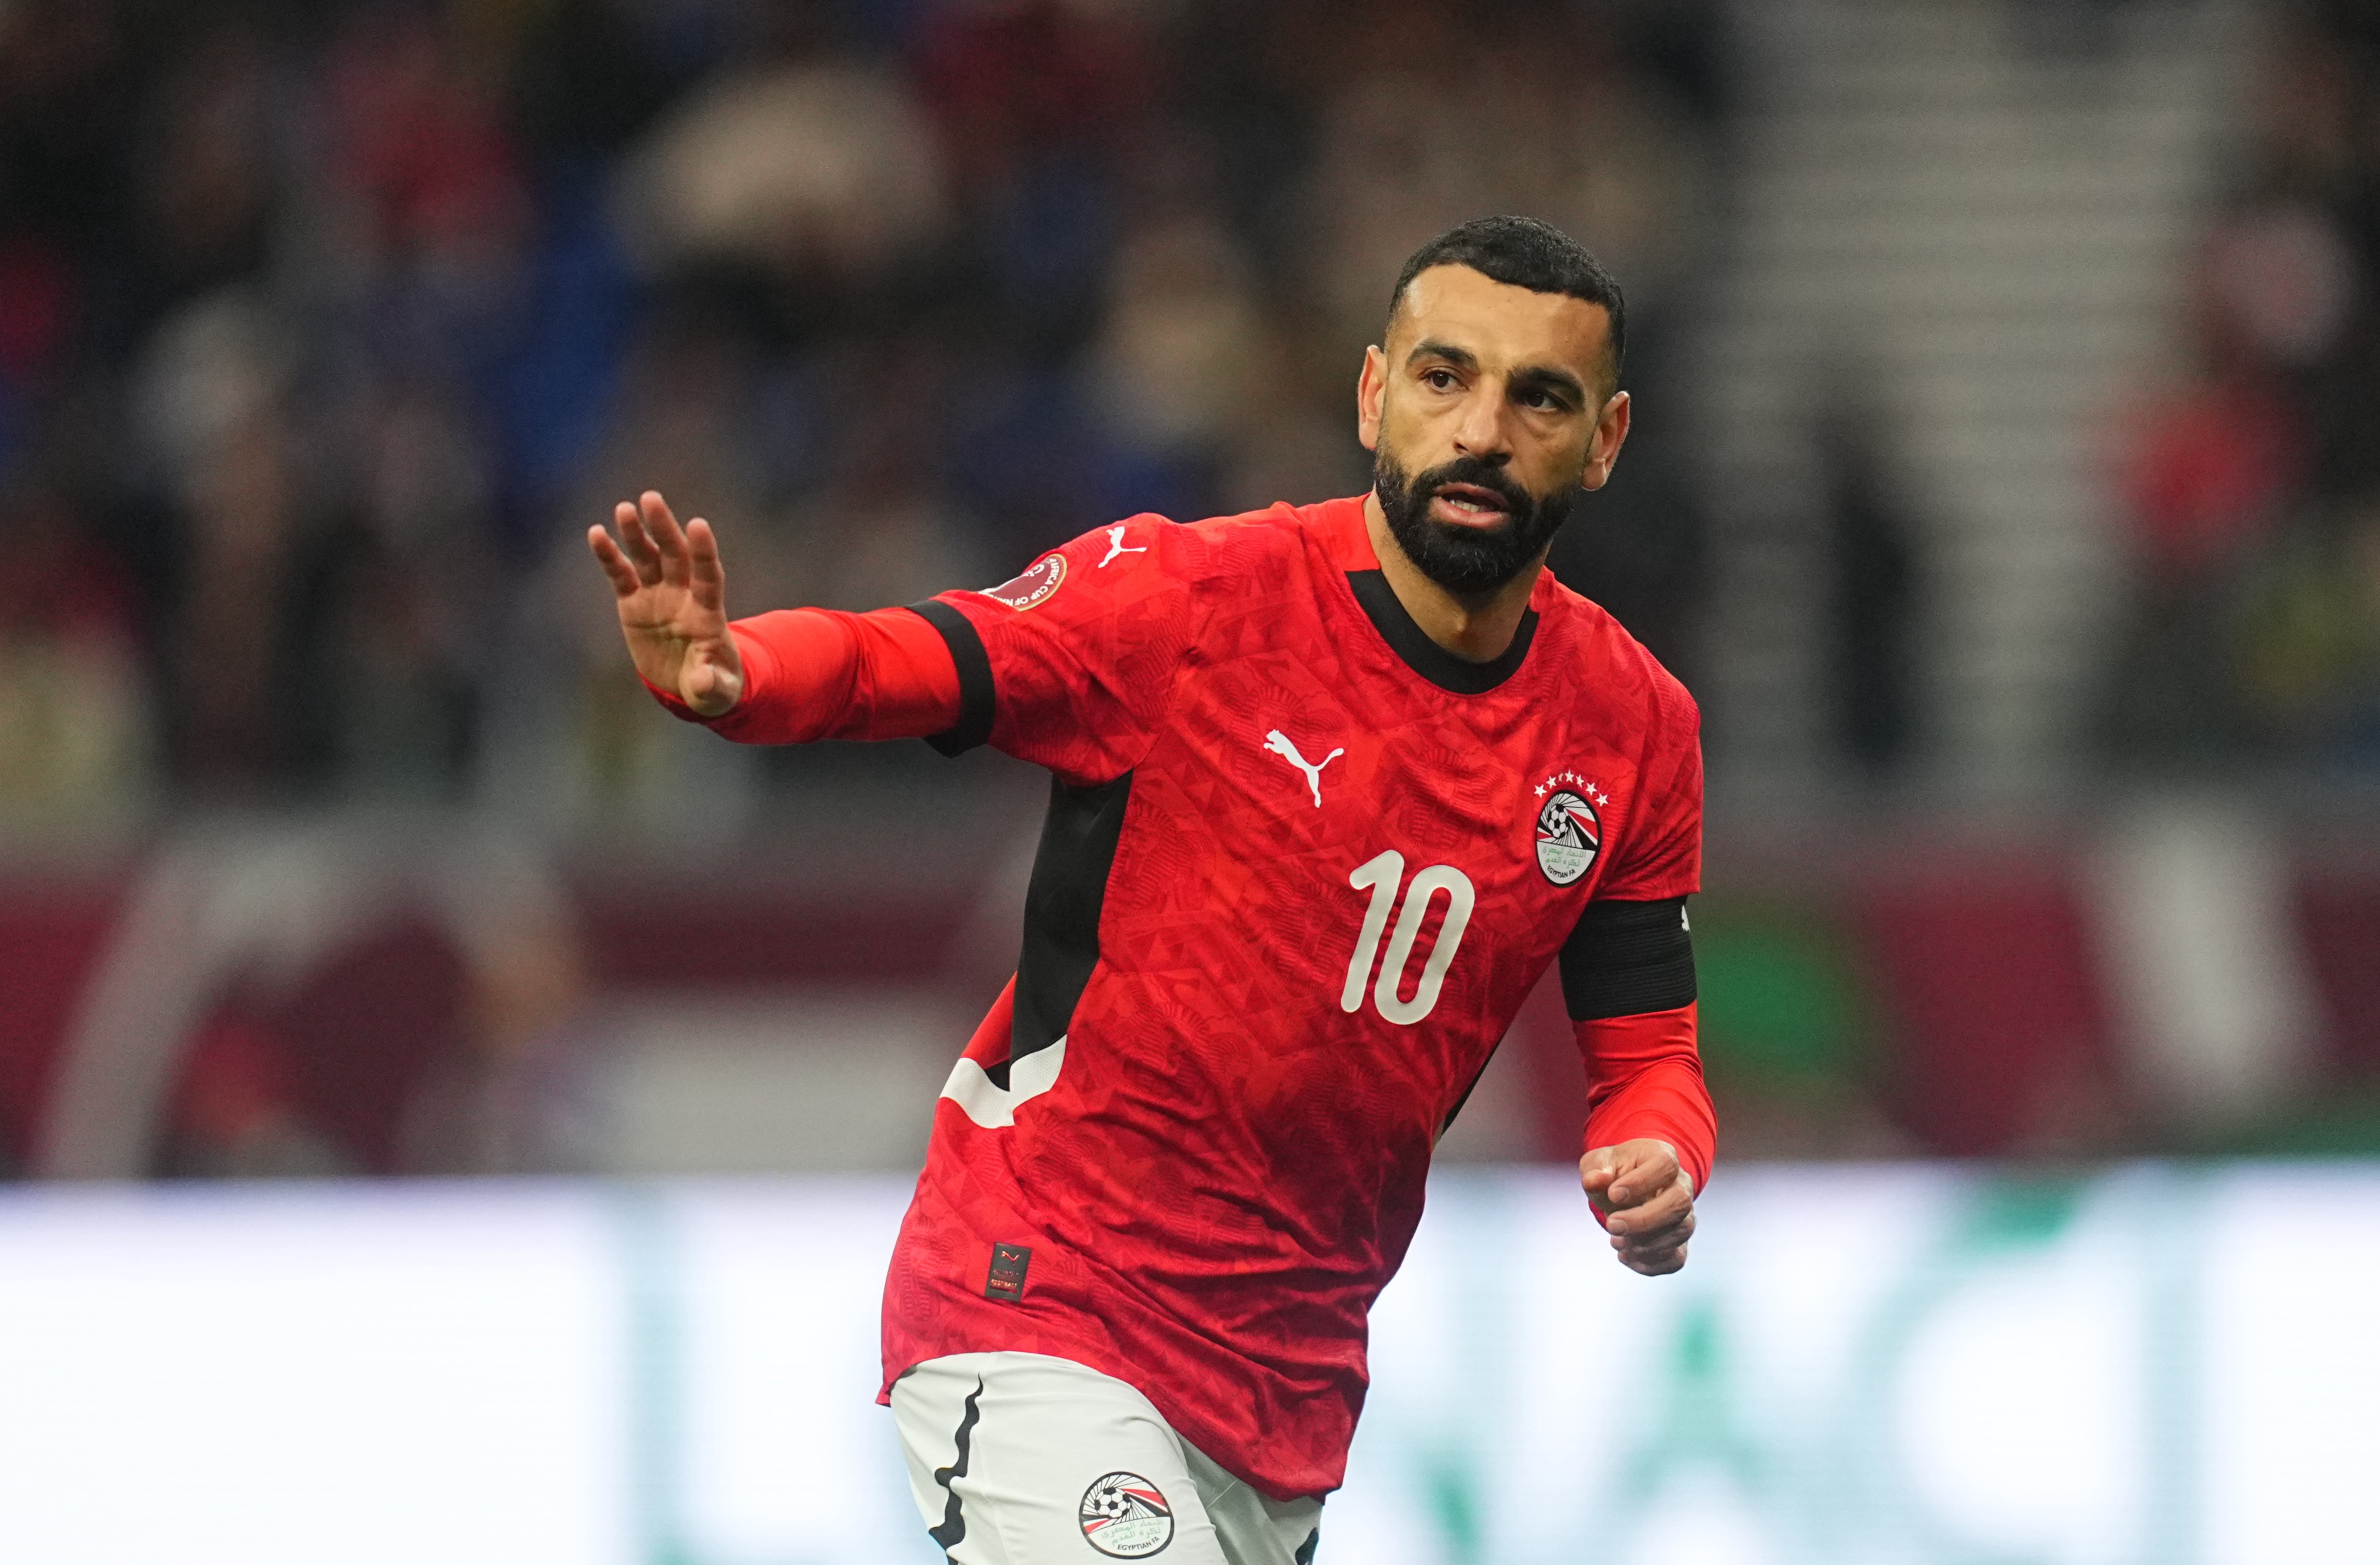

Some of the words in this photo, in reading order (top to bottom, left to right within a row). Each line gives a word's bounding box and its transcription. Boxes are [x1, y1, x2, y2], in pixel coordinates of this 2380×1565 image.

[1031, 586, 1048, 600] CUP
[1015, 597, 1028, 606] OF
[1547, 865, 1568, 878] EGYPTIAN
[1341, 849, 1475, 1025] 10
[1117, 1541, 1151, 1551] EGYPTIAN
